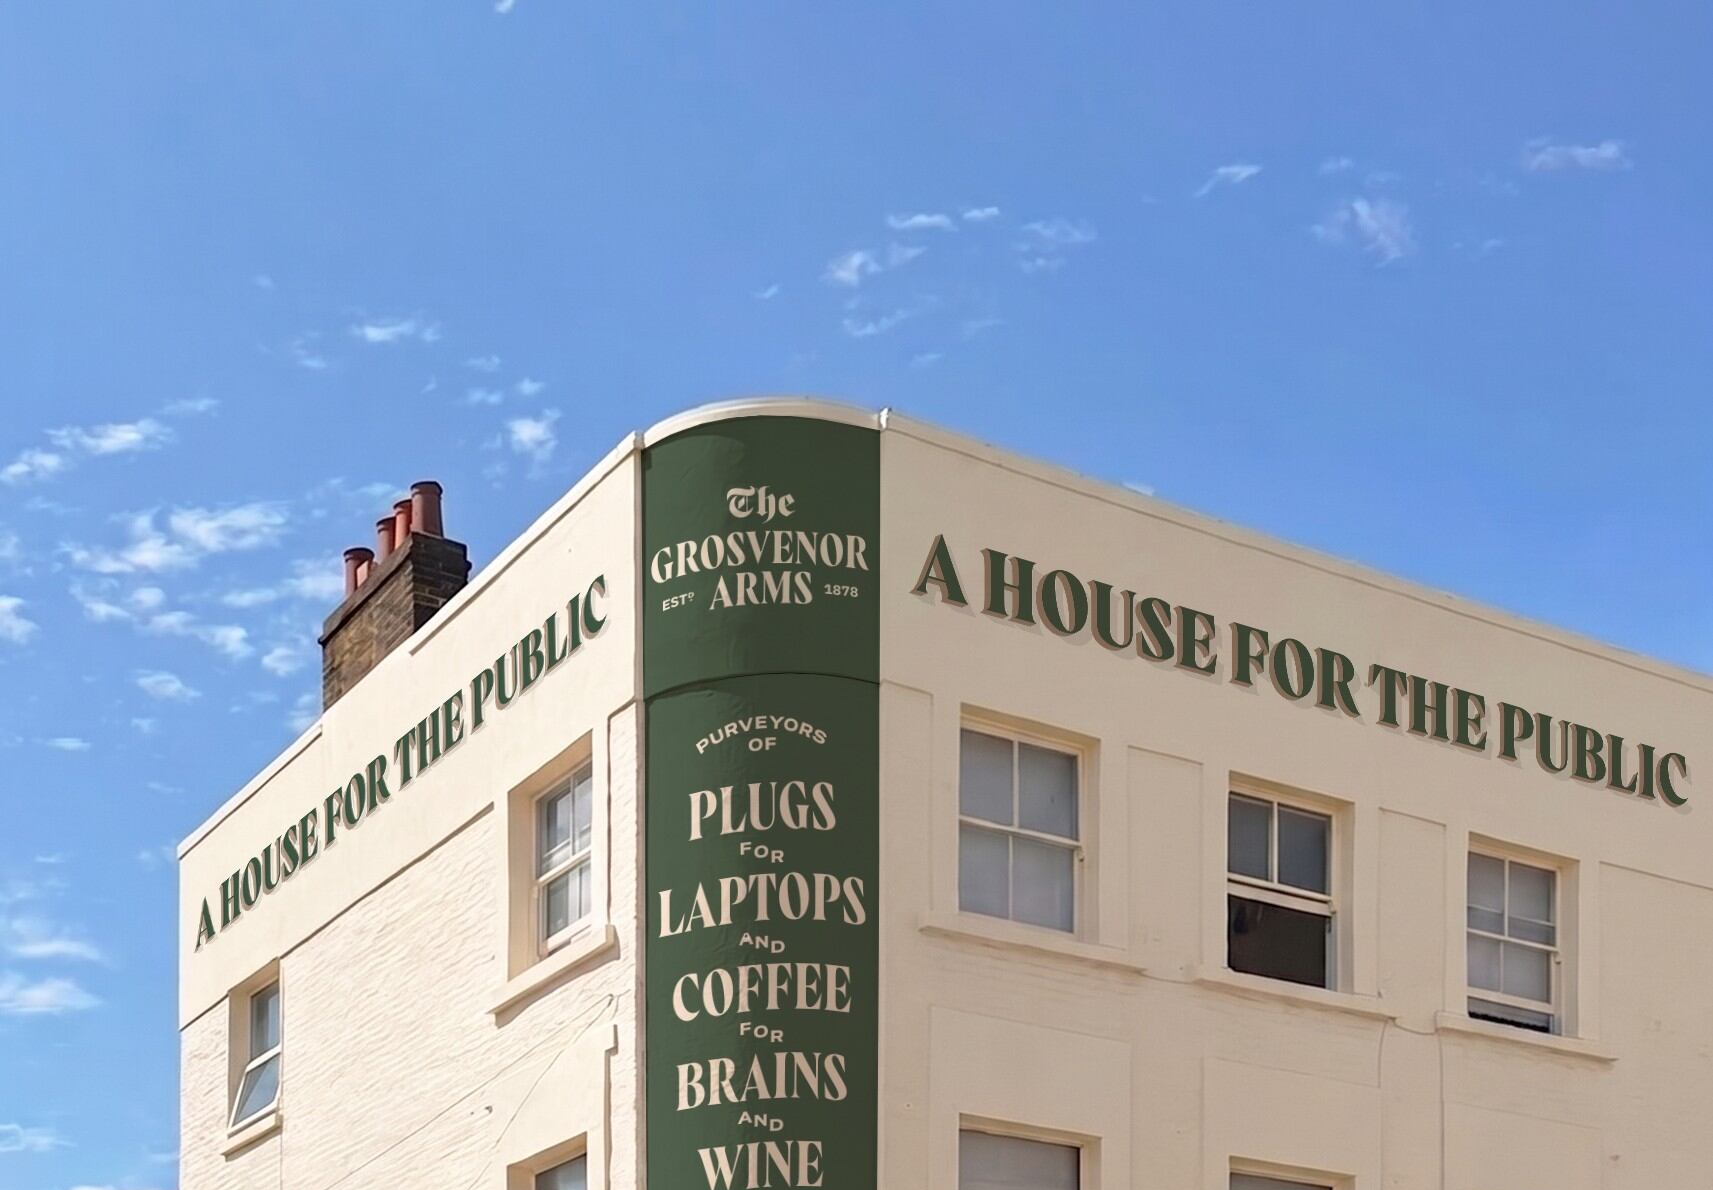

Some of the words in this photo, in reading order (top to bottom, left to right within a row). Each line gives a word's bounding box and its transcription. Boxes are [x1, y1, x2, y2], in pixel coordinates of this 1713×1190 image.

[727, 486, 795, 524] The
[651, 530, 869, 584] GROSVENOR
[709, 571, 813, 610] ARMS
[824, 584, 858, 598] 1878
[909, 534, 969, 608] A
[980, 548, 1218, 676] HOUSE
[1229, 622, 1361, 719] FOR
[1364, 663, 1488, 752] THE
[1497, 701, 1689, 808] PUBLIC
[695, 715, 828, 754] PURVEYORS
[748, 737, 777, 752] OF
[194, 895, 216, 953] A
[219, 807, 320, 932] HOUSE
[323, 753, 392, 849] FOR
[394, 688, 466, 792] THE
[470, 574, 609, 736] PUBLIC
[688, 780, 837, 842] PLUGS
[739, 842, 785, 864] FOR
[658, 872, 866, 938] LAPTOPS
[739, 932, 786, 954] AND
[672, 962, 851, 1022] COFFEE
[739, 1022, 784, 1043] FOR
[676, 1051, 848, 1112] BRAINS
[738, 1111, 785, 1132] AND
